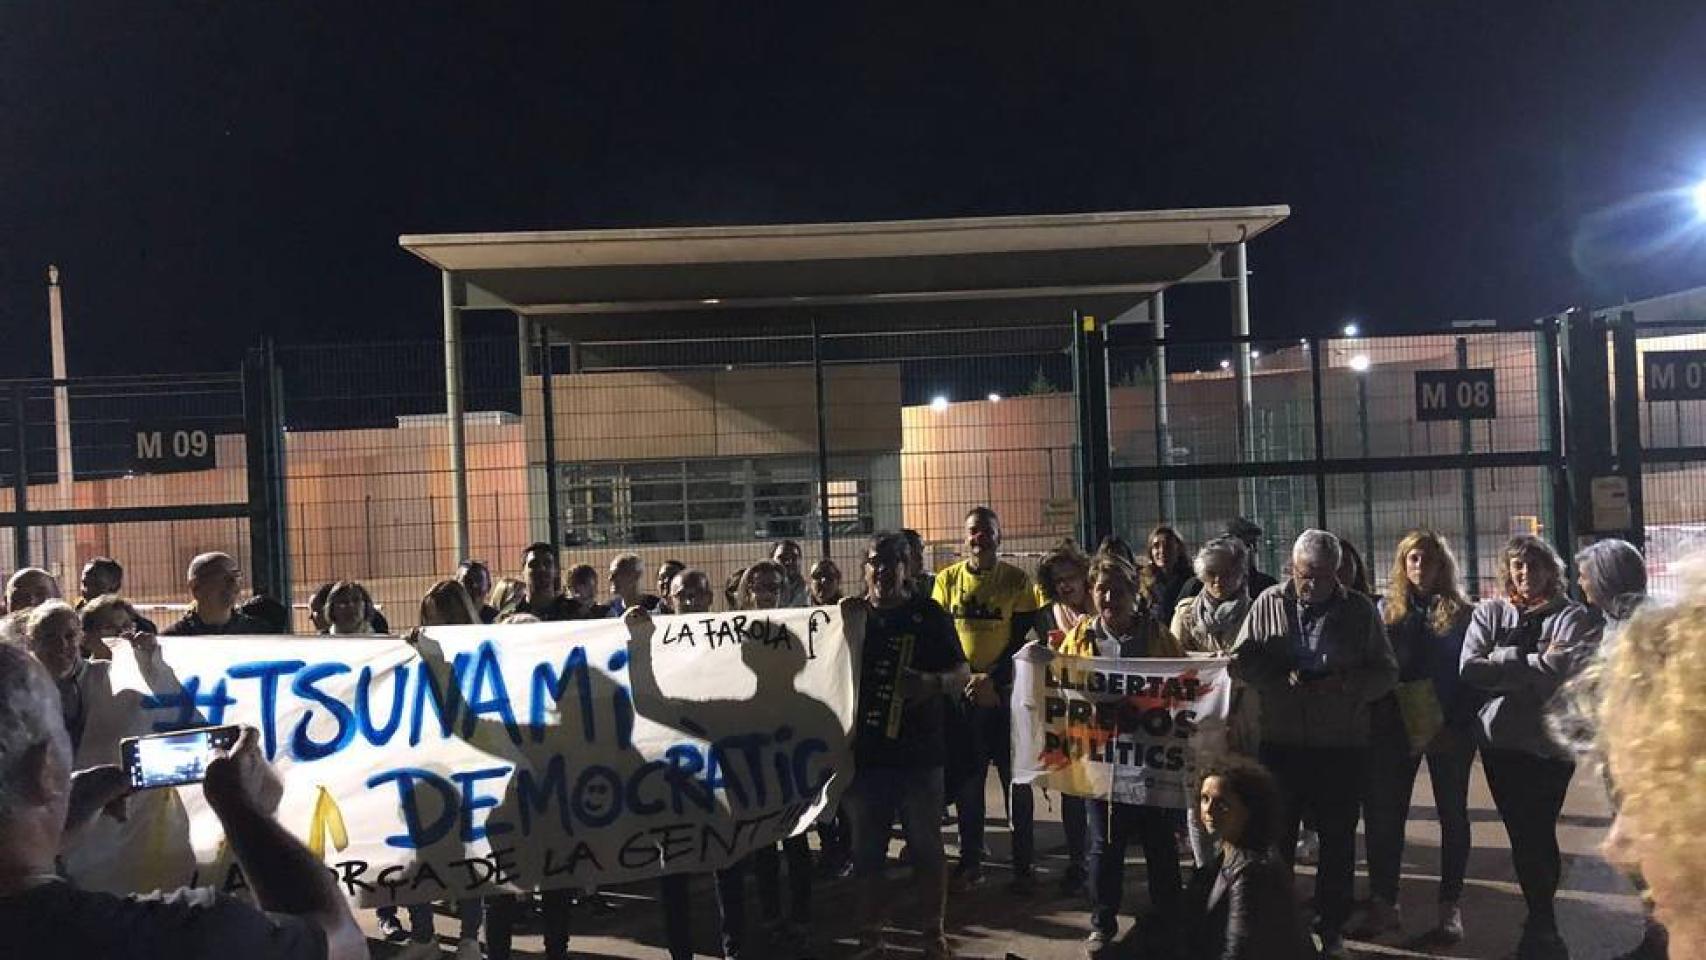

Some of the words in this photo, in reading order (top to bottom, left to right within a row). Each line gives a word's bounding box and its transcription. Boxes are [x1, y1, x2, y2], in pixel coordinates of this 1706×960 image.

[1651, 362, 1676, 390] M
[1686, 360, 1706, 389] 0
[1422, 382, 1447, 410] M
[1456, 380, 1491, 409] 08
[137, 432, 162, 459] M
[173, 430, 208, 457] 09
[662, 618, 697, 647] LA
[699, 614, 792, 649] FAROLA
[449, 847, 520, 889] DE
[543, 842, 602, 875] LA
